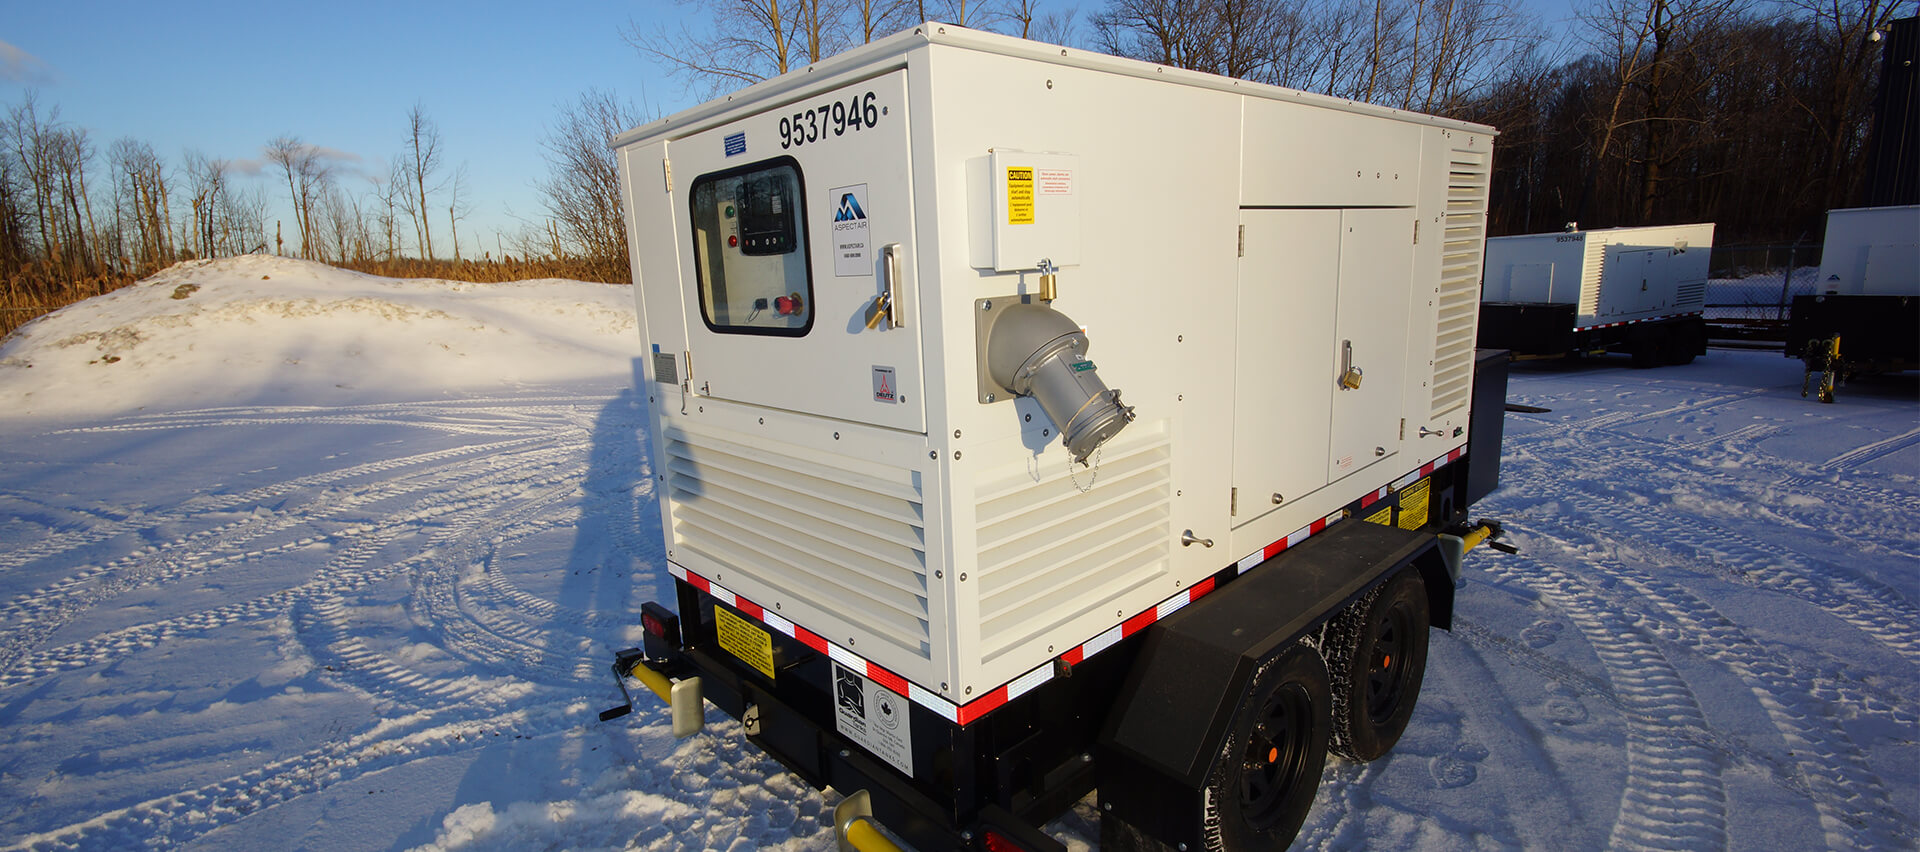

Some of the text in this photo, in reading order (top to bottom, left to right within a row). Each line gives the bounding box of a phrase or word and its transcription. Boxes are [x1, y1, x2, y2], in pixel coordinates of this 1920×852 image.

[780, 91, 878, 150] 9537946
[1009, 170, 1032, 180] CAUTION
[834, 221, 867, 231] ASPECTAIR
[876, 391, 894, 399] DEUTZ
